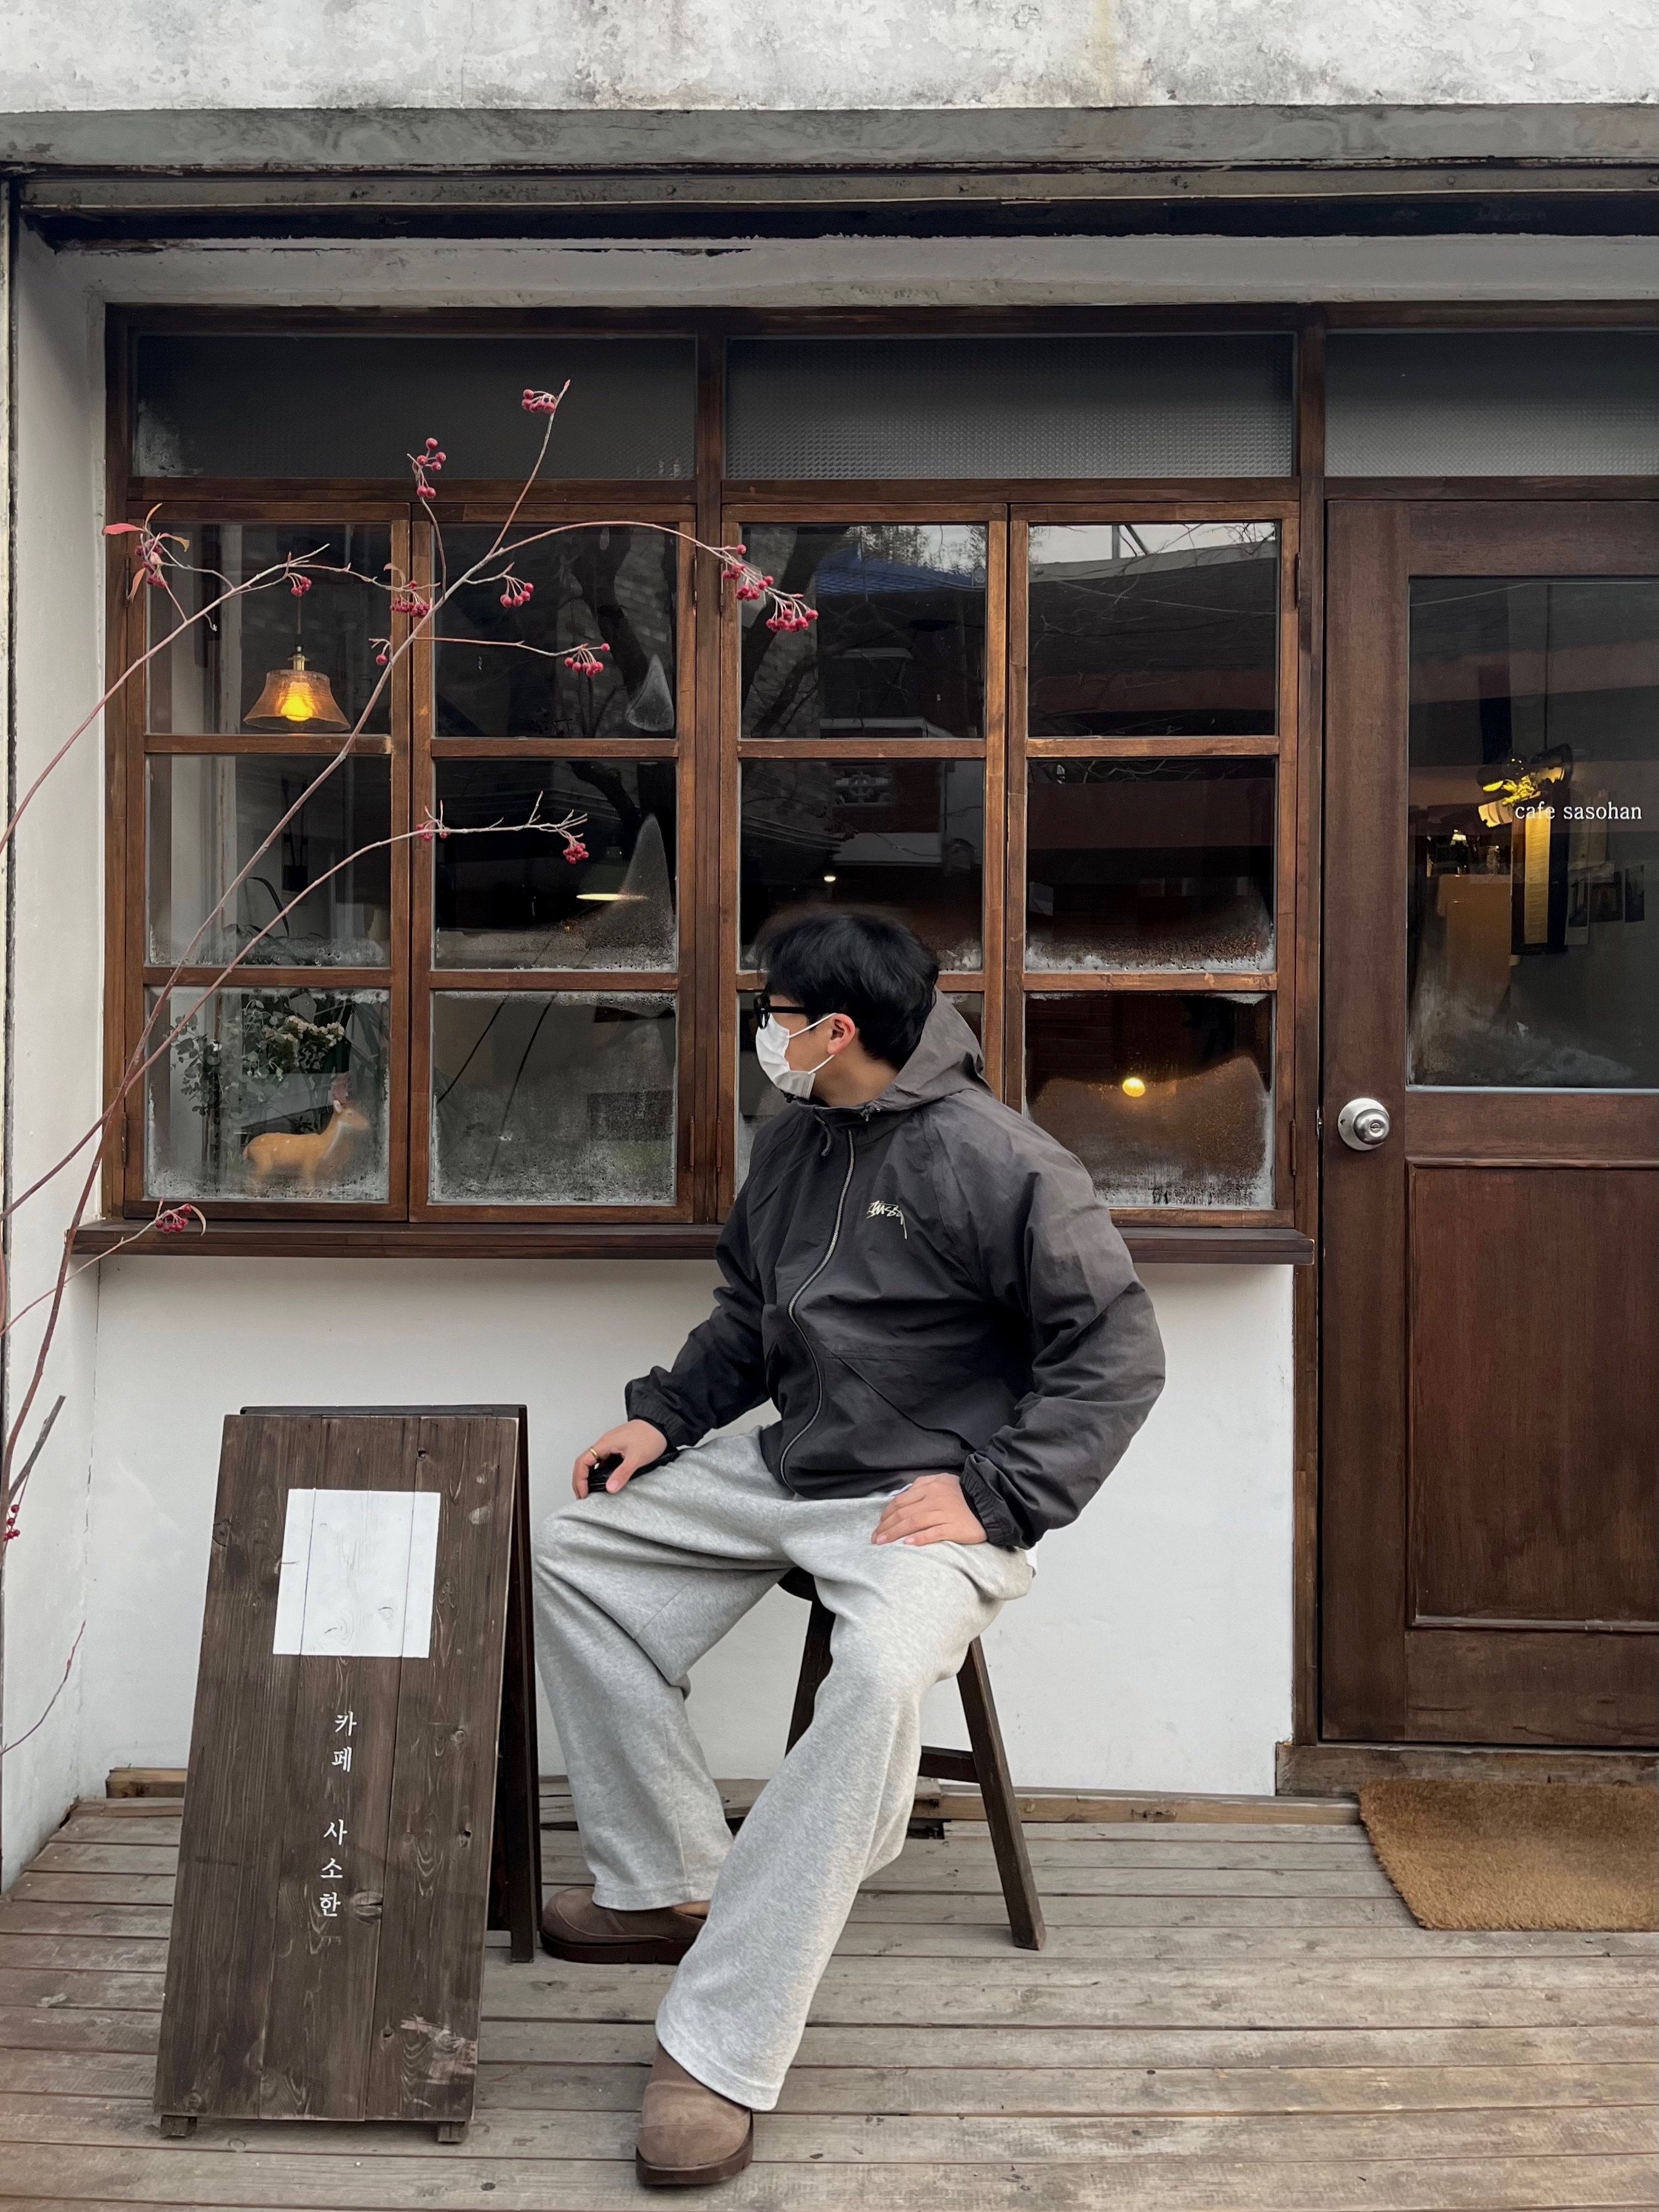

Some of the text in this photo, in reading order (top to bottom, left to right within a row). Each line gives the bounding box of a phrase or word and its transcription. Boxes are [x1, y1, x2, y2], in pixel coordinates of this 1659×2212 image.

[1515, 801, 1642, 820] cafe sasohan
[319, 1710, 357, 1917] 카페 사소한
